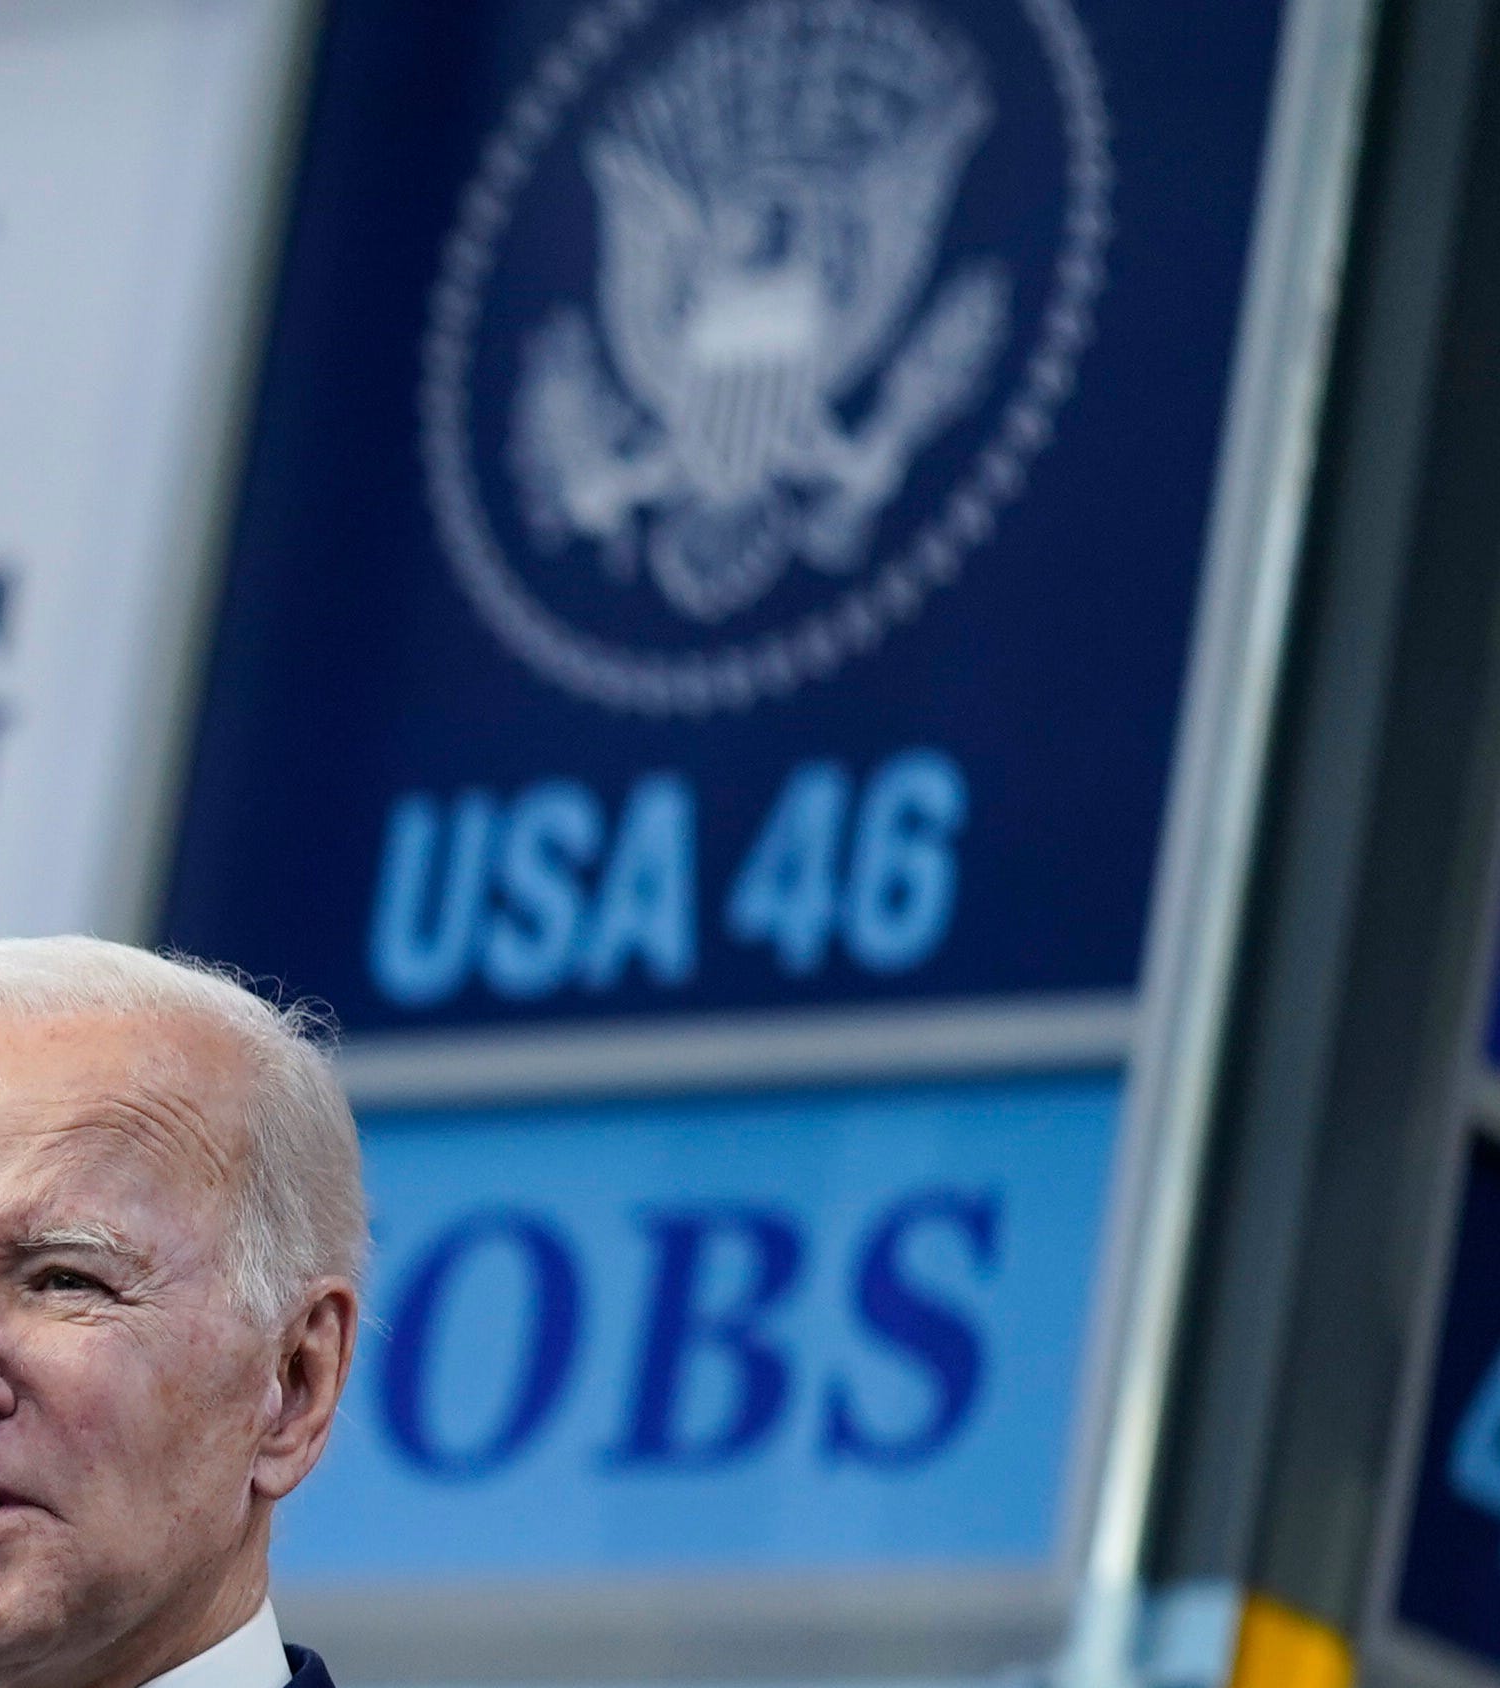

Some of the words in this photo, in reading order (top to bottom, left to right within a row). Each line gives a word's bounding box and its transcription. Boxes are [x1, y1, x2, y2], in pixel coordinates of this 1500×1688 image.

[367, 774, 697, 1008] USA
[727, 748, 969, 975] 46
[373, 1182, 1005, 1487] OBS
